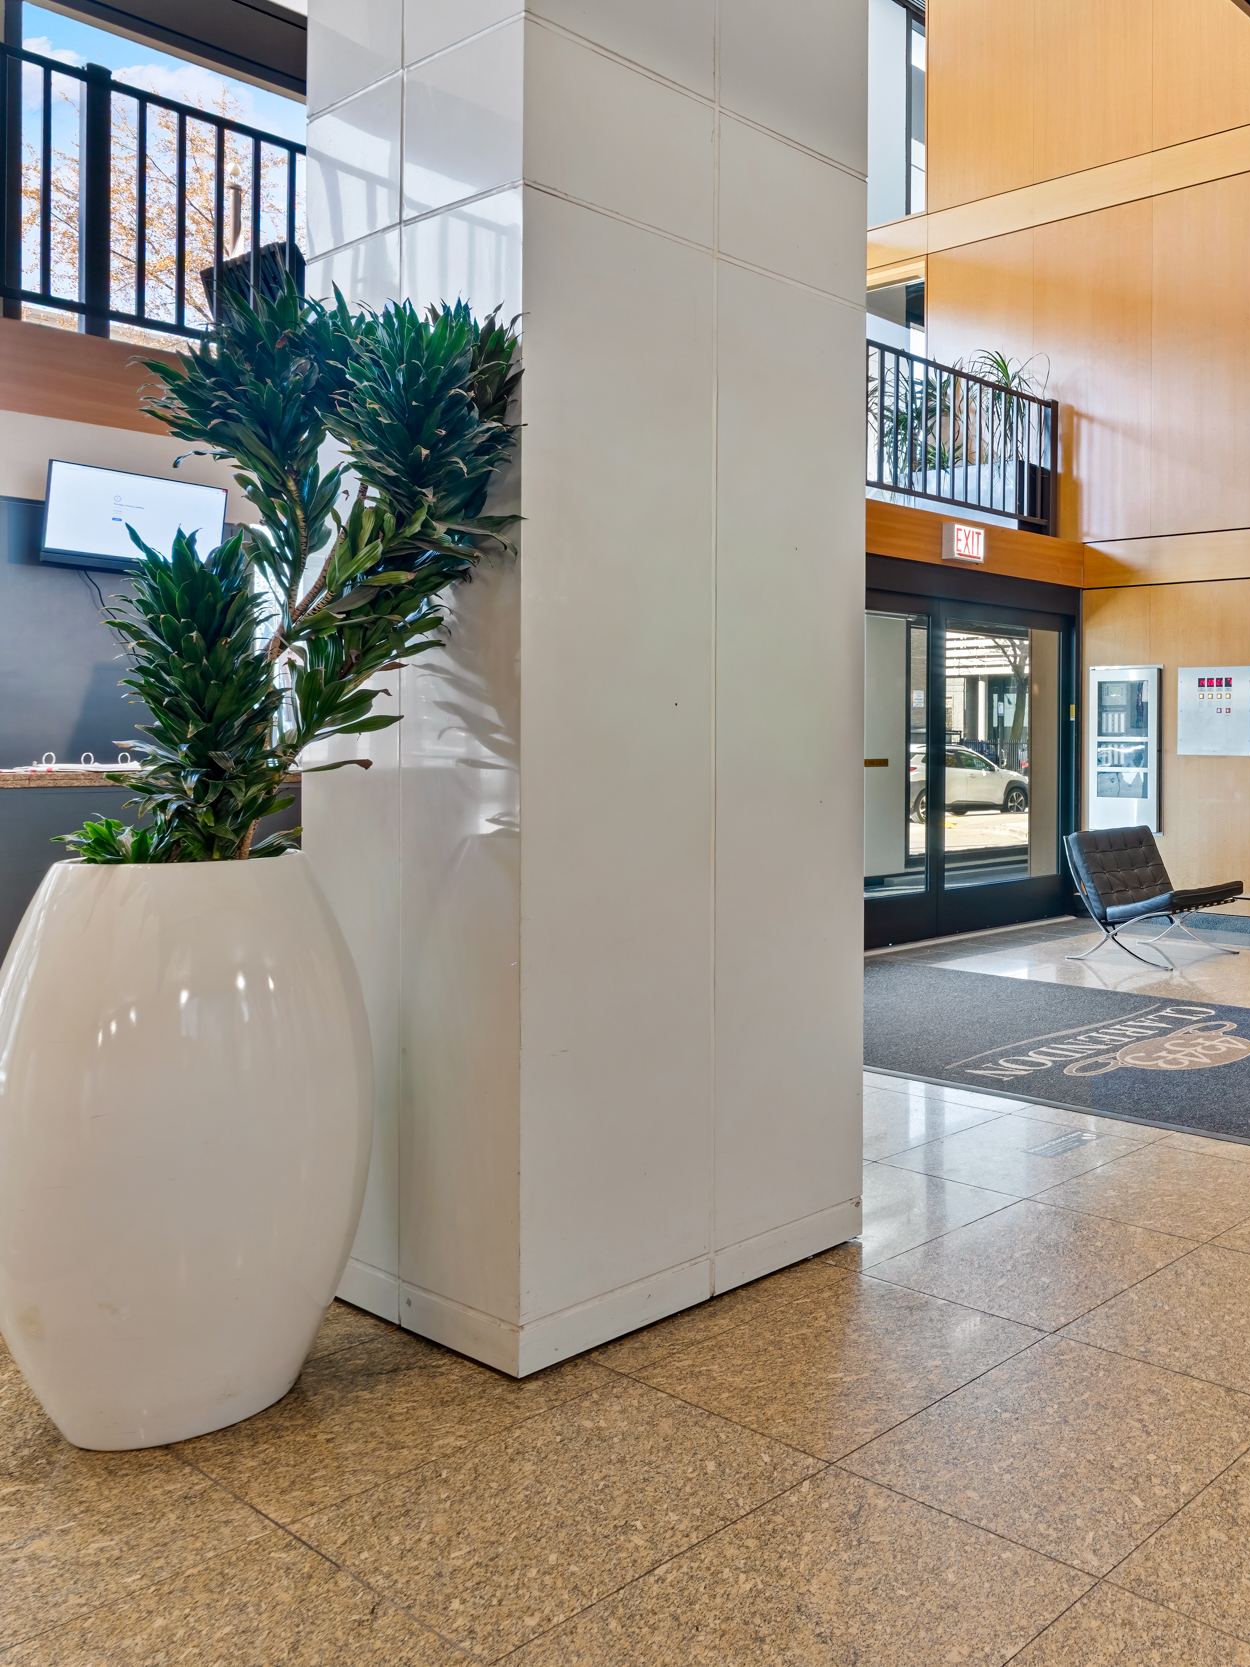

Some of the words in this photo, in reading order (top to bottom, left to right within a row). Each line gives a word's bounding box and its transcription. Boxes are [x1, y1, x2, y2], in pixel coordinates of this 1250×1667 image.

[956, 527, 982, 555] EXIT
[965, 1006, 1216, 1081] CLARENDON
[1124, 1036, 1248, 1069] 4343
